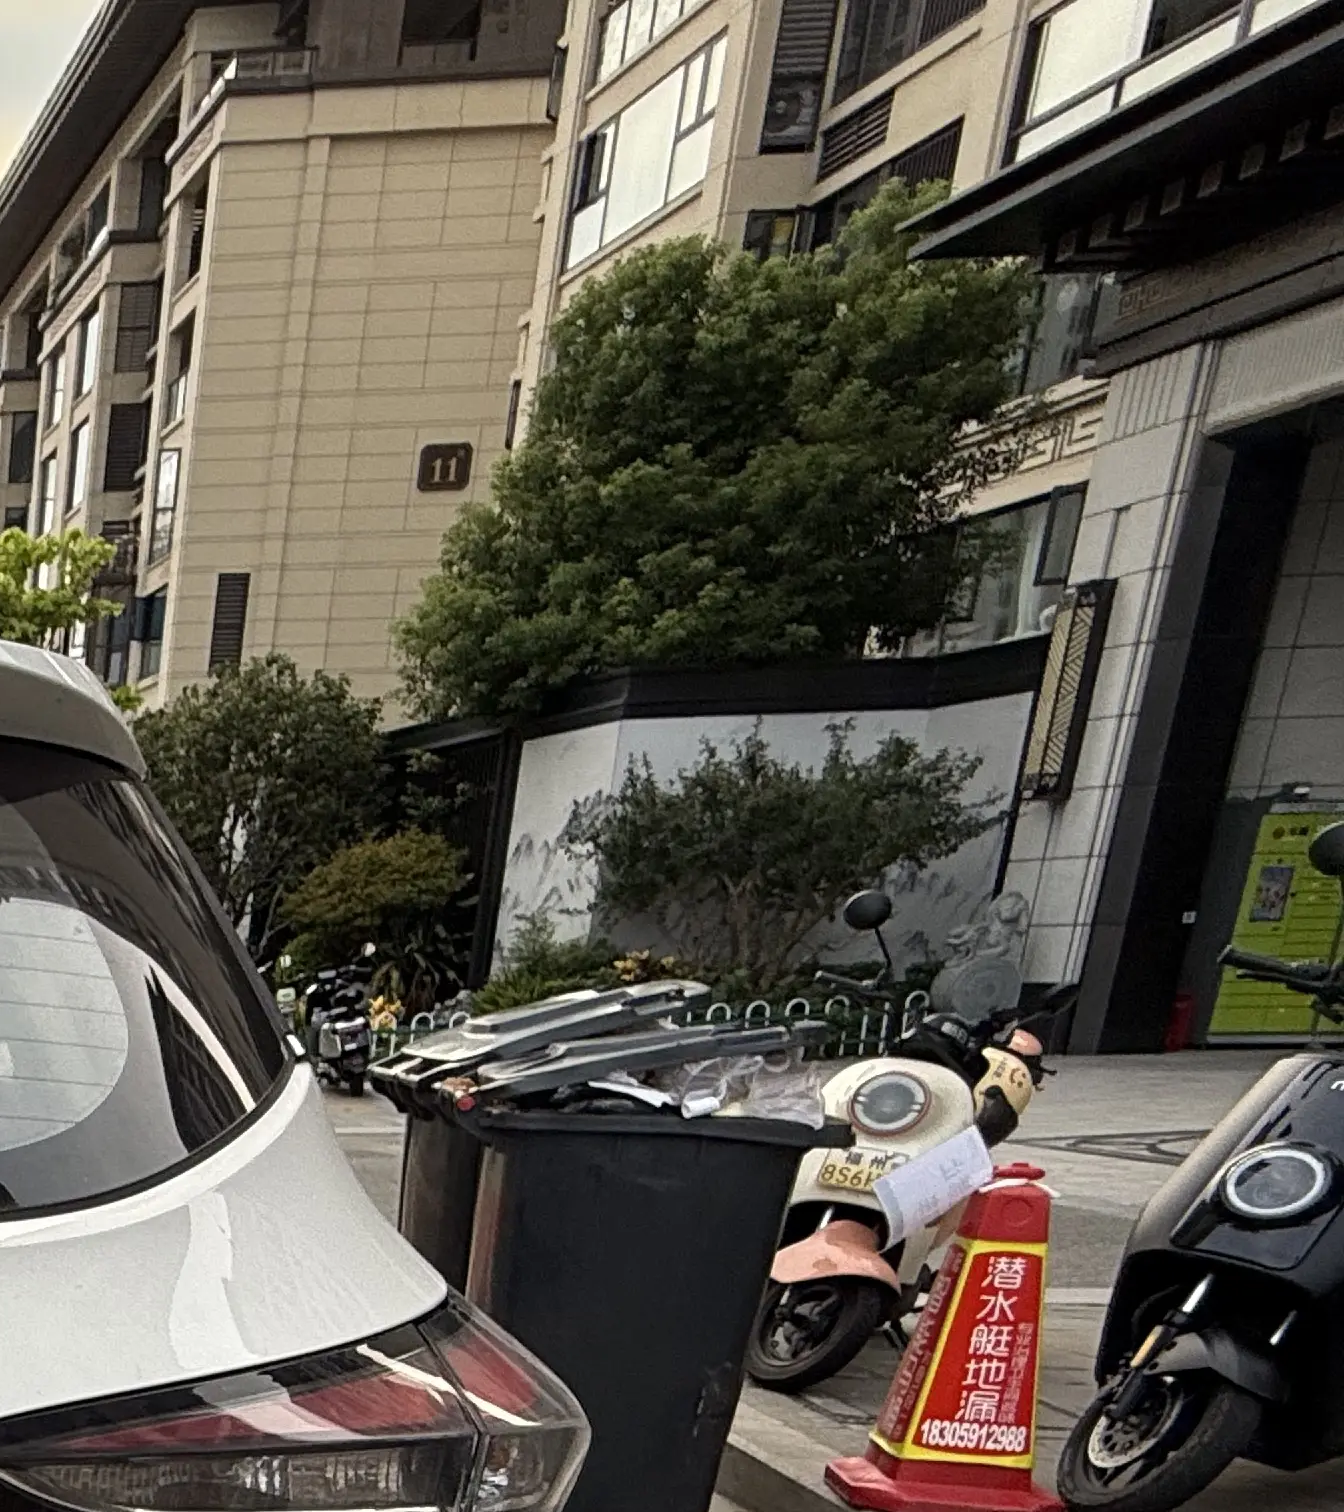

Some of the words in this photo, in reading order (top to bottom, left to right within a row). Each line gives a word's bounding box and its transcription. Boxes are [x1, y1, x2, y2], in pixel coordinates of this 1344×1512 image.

[954, 1256, 1027, 1423] 潜水艇地漏
[920, 1418, 1027, 1453] 18305912988
